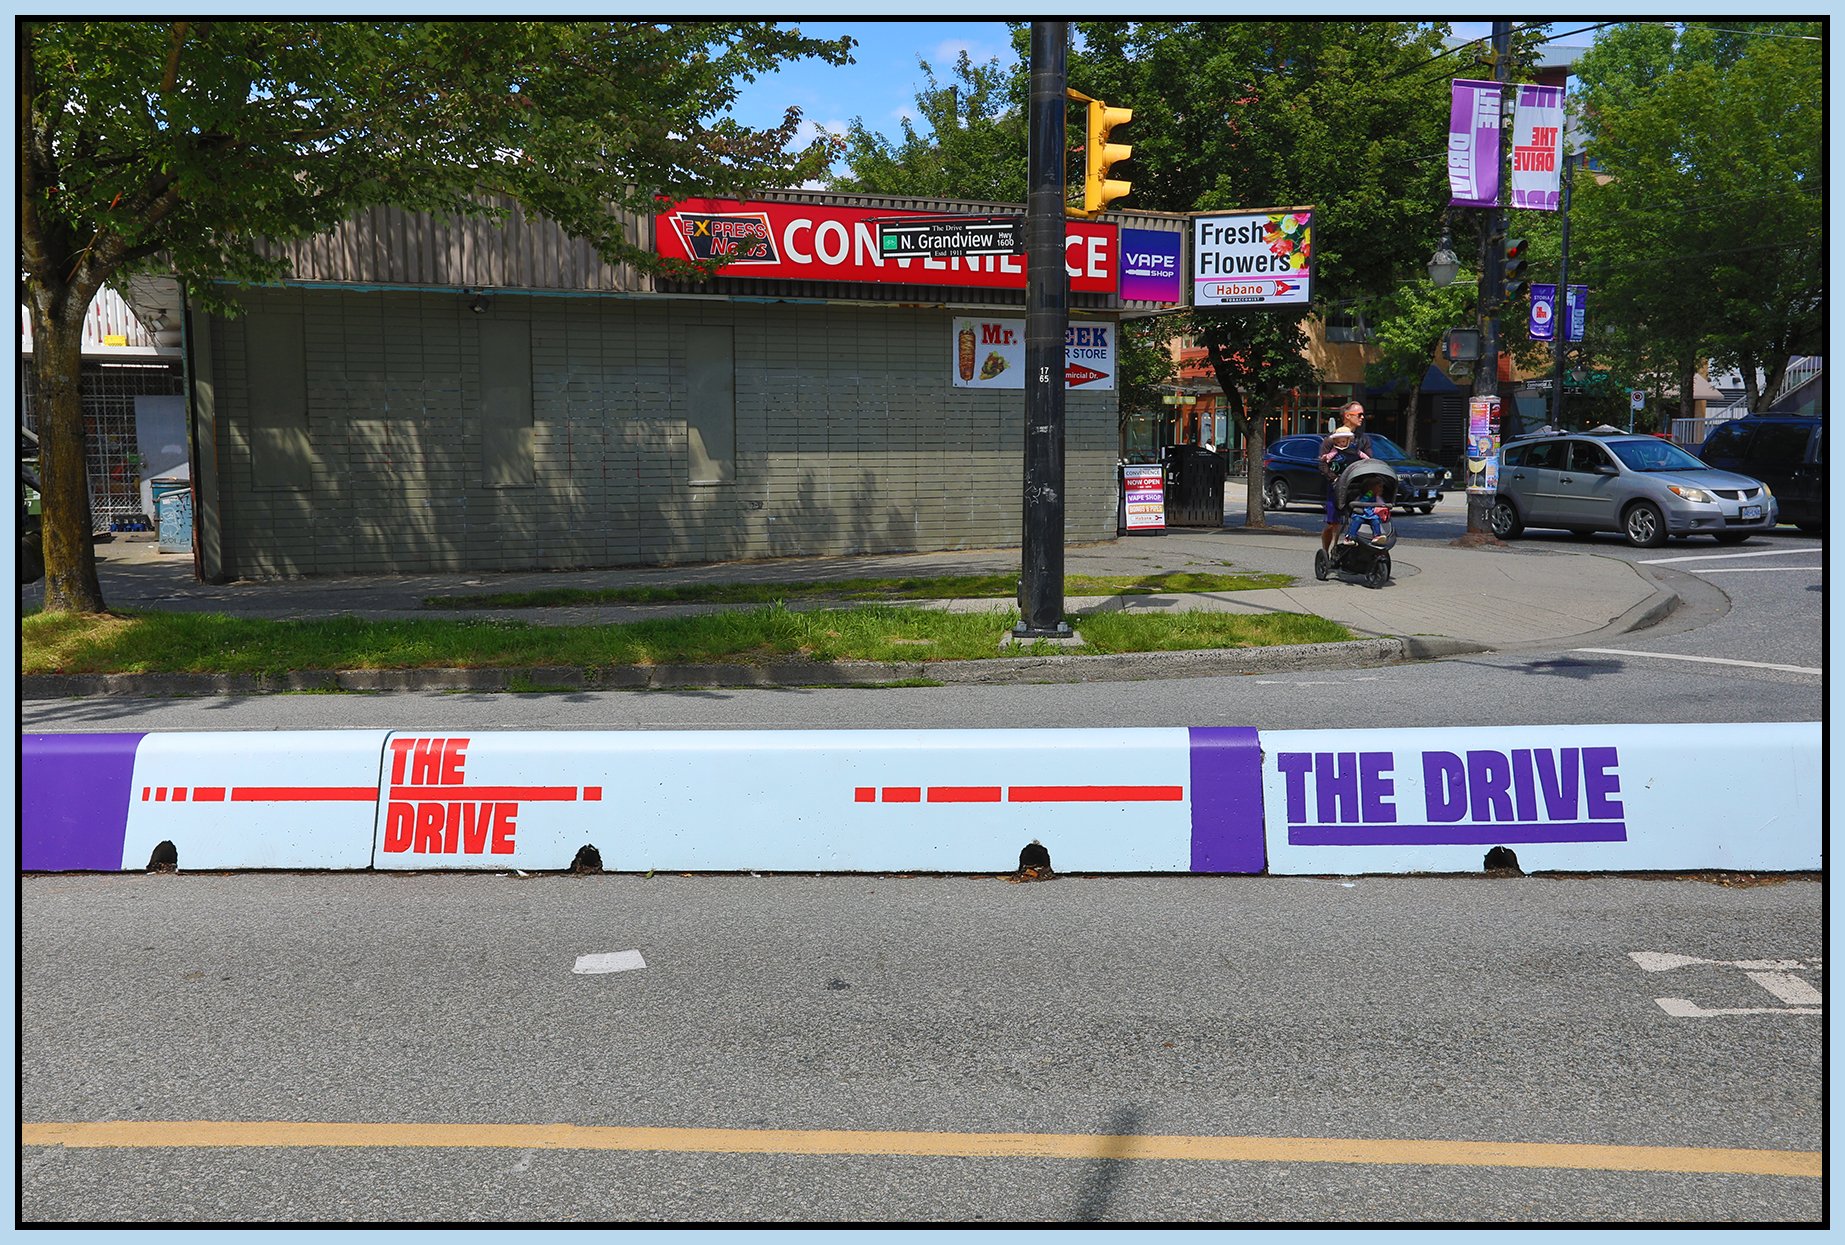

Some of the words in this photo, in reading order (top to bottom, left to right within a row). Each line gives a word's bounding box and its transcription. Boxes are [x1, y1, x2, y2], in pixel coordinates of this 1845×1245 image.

[682, 219, 768, 239] EXPRESS
[946, 224, 963, 232] Drive
[1200, 221, 1264, 246] Fresh
[901, 235, 915, 250] N.
[918, 231, 993, 249] Grandview
[997, 239, 1015, 247] 1600
[998, 232, 1013, 240] Hwy
[1125, 252, 1176, 268] VAPE
[1200, 251, 1291, 275] Flowers
[1150, 269, 1175, 279] SHOP
[1216, 283, 1264, 295] Habano
[981, 324, 1018, 346] Mr.
[1073, 349, 1107, 359] STORE
[1040, 367, 1050, 375] 17
[1089, 371, 1099, 379] Dr.
[1039, 375, 1050, 383] 65
[388, 738, 471, 786] THE
[1277, 751, 1398, 824] THE
[1421, 746, 1626, 823] DRIVE
[382, 802, 520, 855] DRIVE
